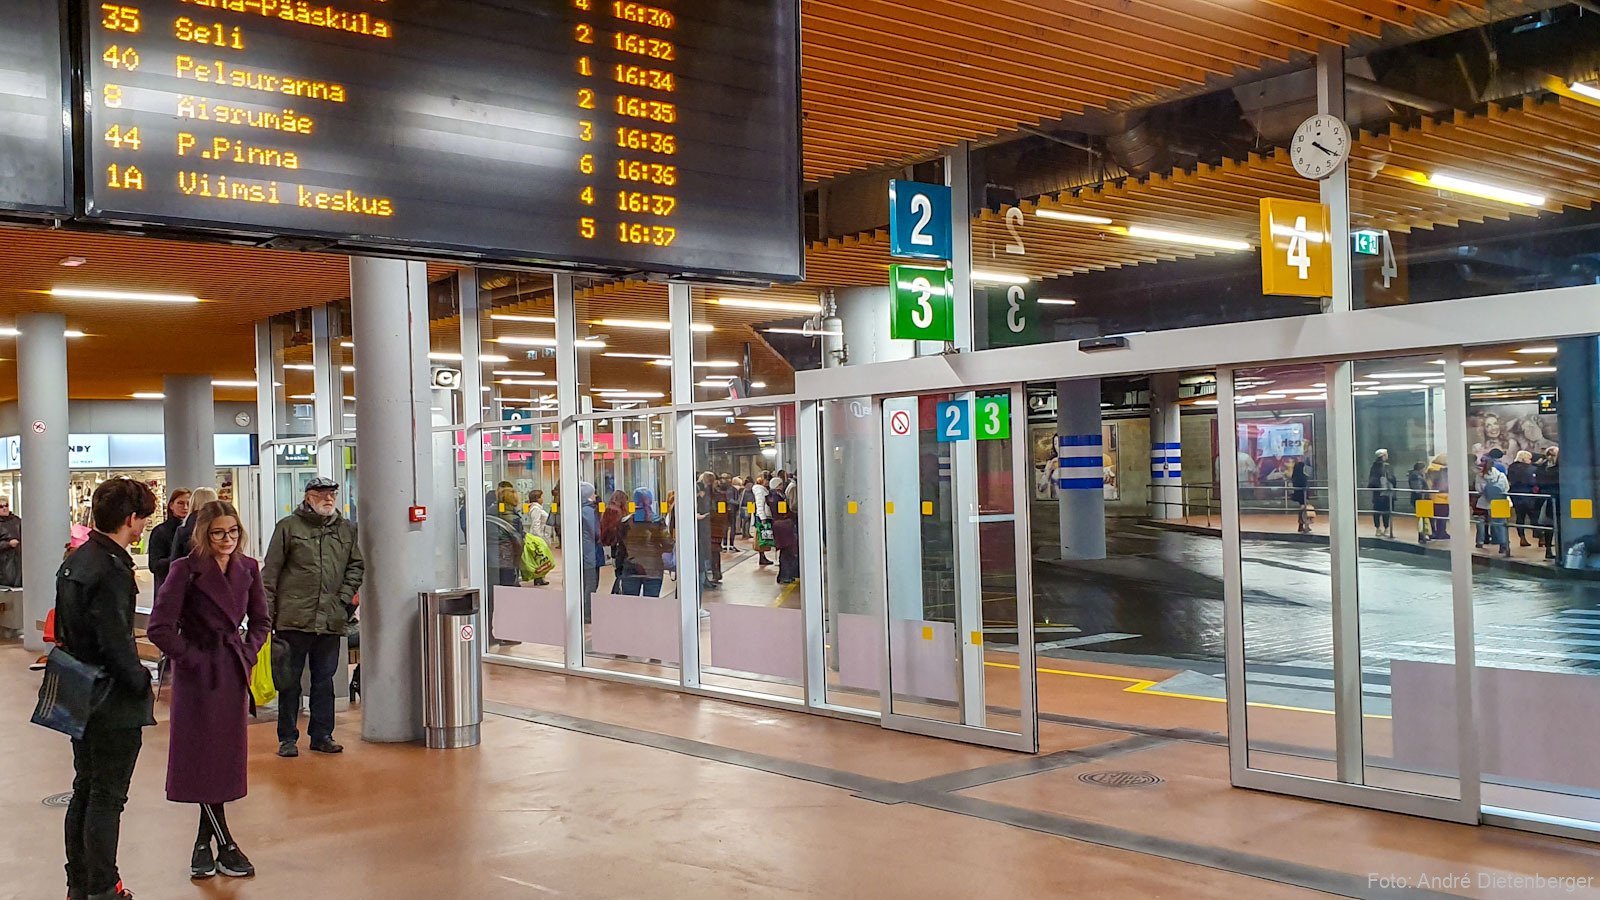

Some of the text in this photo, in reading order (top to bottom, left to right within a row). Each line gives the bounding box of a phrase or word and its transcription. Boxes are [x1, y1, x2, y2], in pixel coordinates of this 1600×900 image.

[613, 0, 674, 29] 16:30
[101, 3, 676, 123] 35 Seli 2 16:35
[576, 24, 674, 61] 2 16:32
[103, 44, 675, 155] 40 Pelguranna 3 16:36
[579, 57, 593, 76] 1
[615, 64, 674, 92] 16:34
[103, 83, 675, 186] 8 Äigrumäe 6 16:36
[104, 124, 675, 216] 44 P.Pinna 4 16:37
[107, 163, 676, 247] 1A Viimsi keskus 5 16:37
[911, 193, 933, 246] 2
[1287, 216, 1310, 280] 4
[911, 277, 933, 329] 3
[632, 431, 639, 445] 1
[945, 405, 961, 436] 2
[984, 402, 1000, 435] 3
